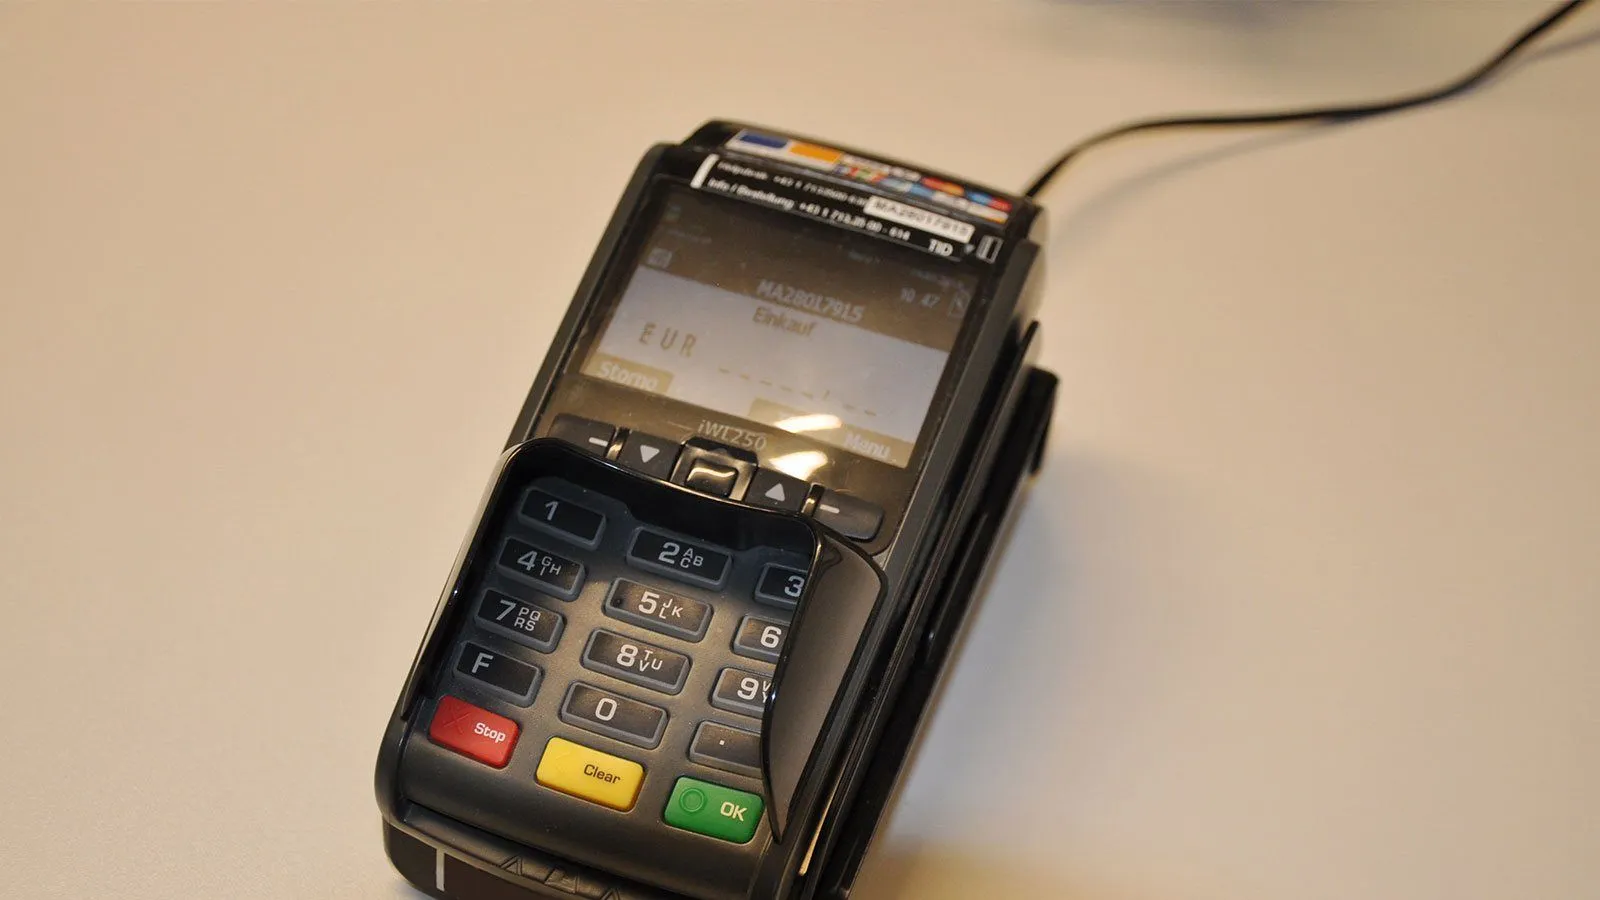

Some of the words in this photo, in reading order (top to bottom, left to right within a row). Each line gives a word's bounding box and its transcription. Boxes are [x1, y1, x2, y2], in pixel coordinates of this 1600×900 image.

[707, 177, 731, 192] Info
[928, 238, 954, 257] TID
[752, 306, 818, 338] Einkauf
[639, 321, 697, 358] EUR
[600, 360, 660, 391] Storno
[543, 500, 559, 522] 1
[517, 550, 537, 572] 4
[658, 541, 680, 566] 2
[784, 575, 805, 598] 3
[496, 599, 517, 621] 7
[638, 591, 661, 615] 5
[760, 625, 782, 649] 6
[471, 652, 494, 674] F
[616, 643, 638, 667] 8
[737, 677, 760, 700] 9
[594, 697, 617, 722] 0
[473, 722, 507, 744] Stop
[583, 763, 622, 786] Clear
[719, 802, 750, 822] OK
